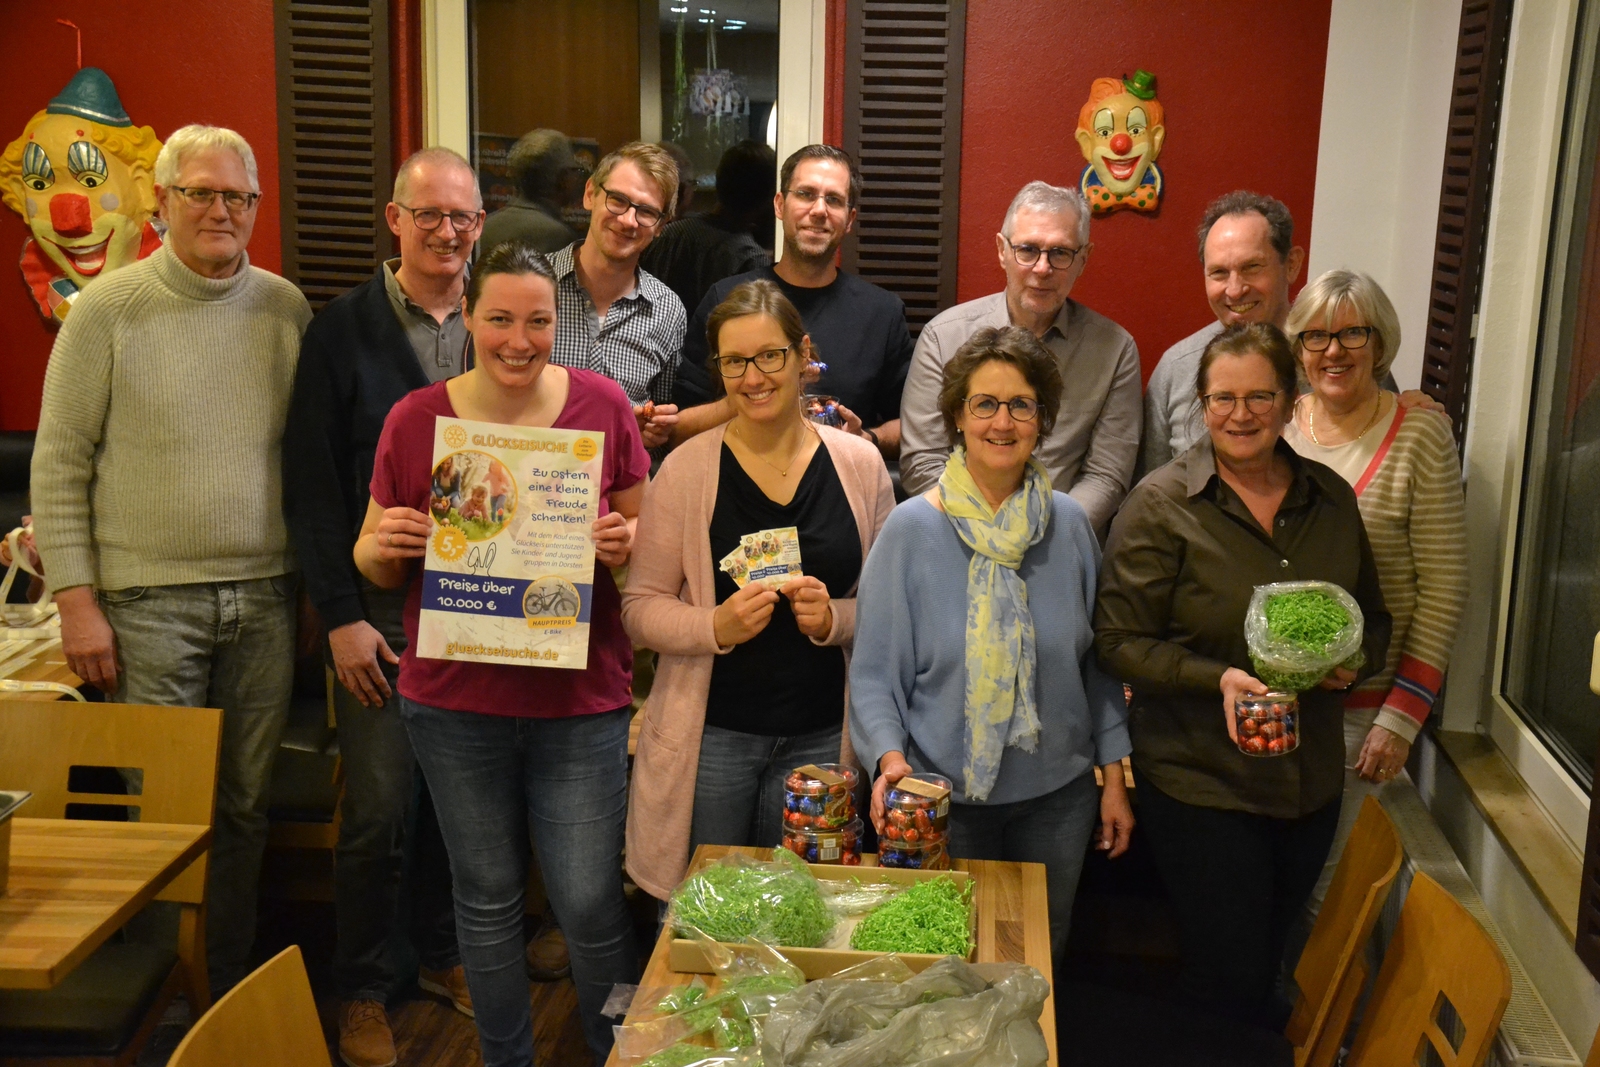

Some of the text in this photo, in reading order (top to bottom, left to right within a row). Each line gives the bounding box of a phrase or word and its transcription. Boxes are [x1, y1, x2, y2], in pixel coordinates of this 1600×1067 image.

[472, 434, 568, 453] GLÜCKSEISUCHE
[532, 468, 590, 480] Zu Ostern
[528, 482, 588, 495] eine kleine
[546, 499, 587, 509] Freude
[440, 536, 463, 557] 5,-
[438, 578, 515, 595] Preise über
[437, 596, 497, 610] 10.000 €
[446, 642, 559, 660] glueckseisuche.de
